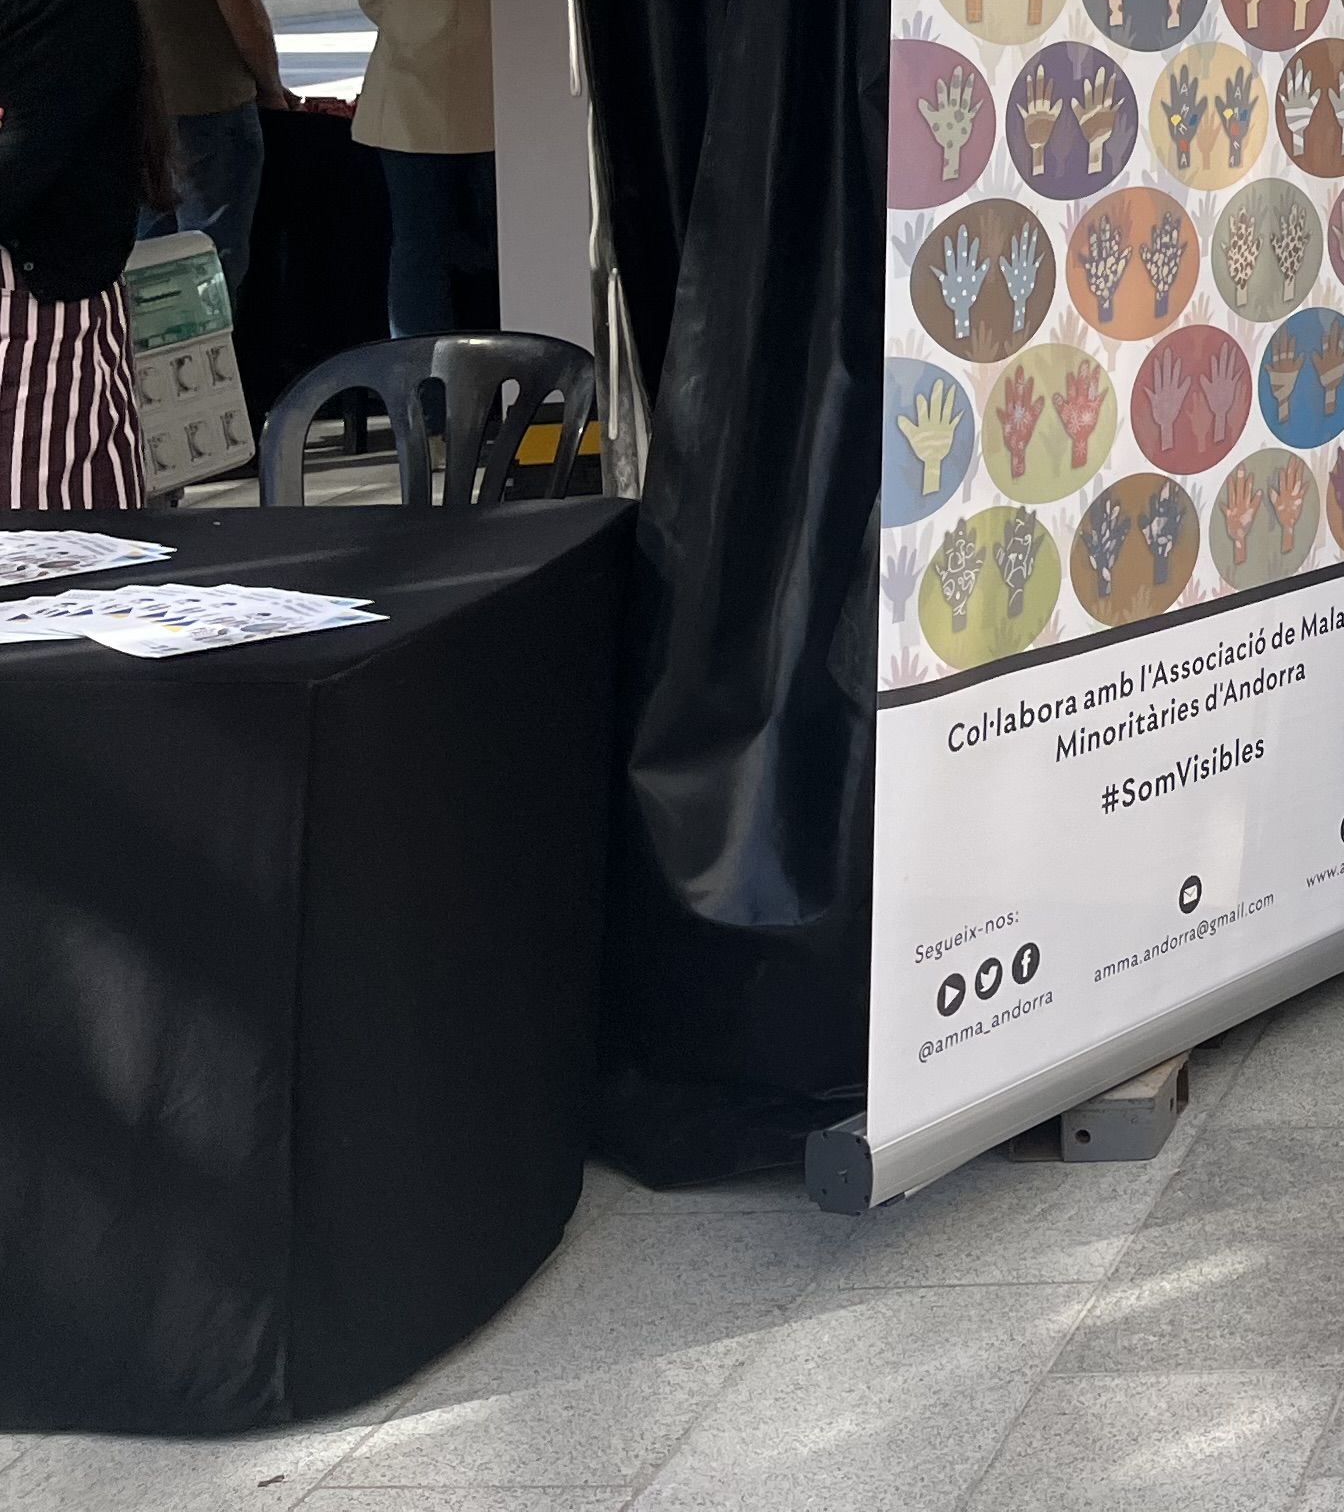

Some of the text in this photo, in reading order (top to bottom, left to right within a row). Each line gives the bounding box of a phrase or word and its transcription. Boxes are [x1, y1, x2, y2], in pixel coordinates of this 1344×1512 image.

[947, 694, 1078, 753] Col·labora
[1083, 670, 1134, 711] amb
[1140, 627, 1266, 692] l'Associació
[1271, 622, 1296, 650] de
[1055, 662, 1306, 763] Minoritàries d'Andorra
[1101, 738, 1265, 815] #SomVisibles
[915, 910, 1019, 964] Segueix-nos:
[1093, 892, 1275, 983] amma.andorra@gmail.com
[918, 990, 1054, 1064] @amma_andorra
